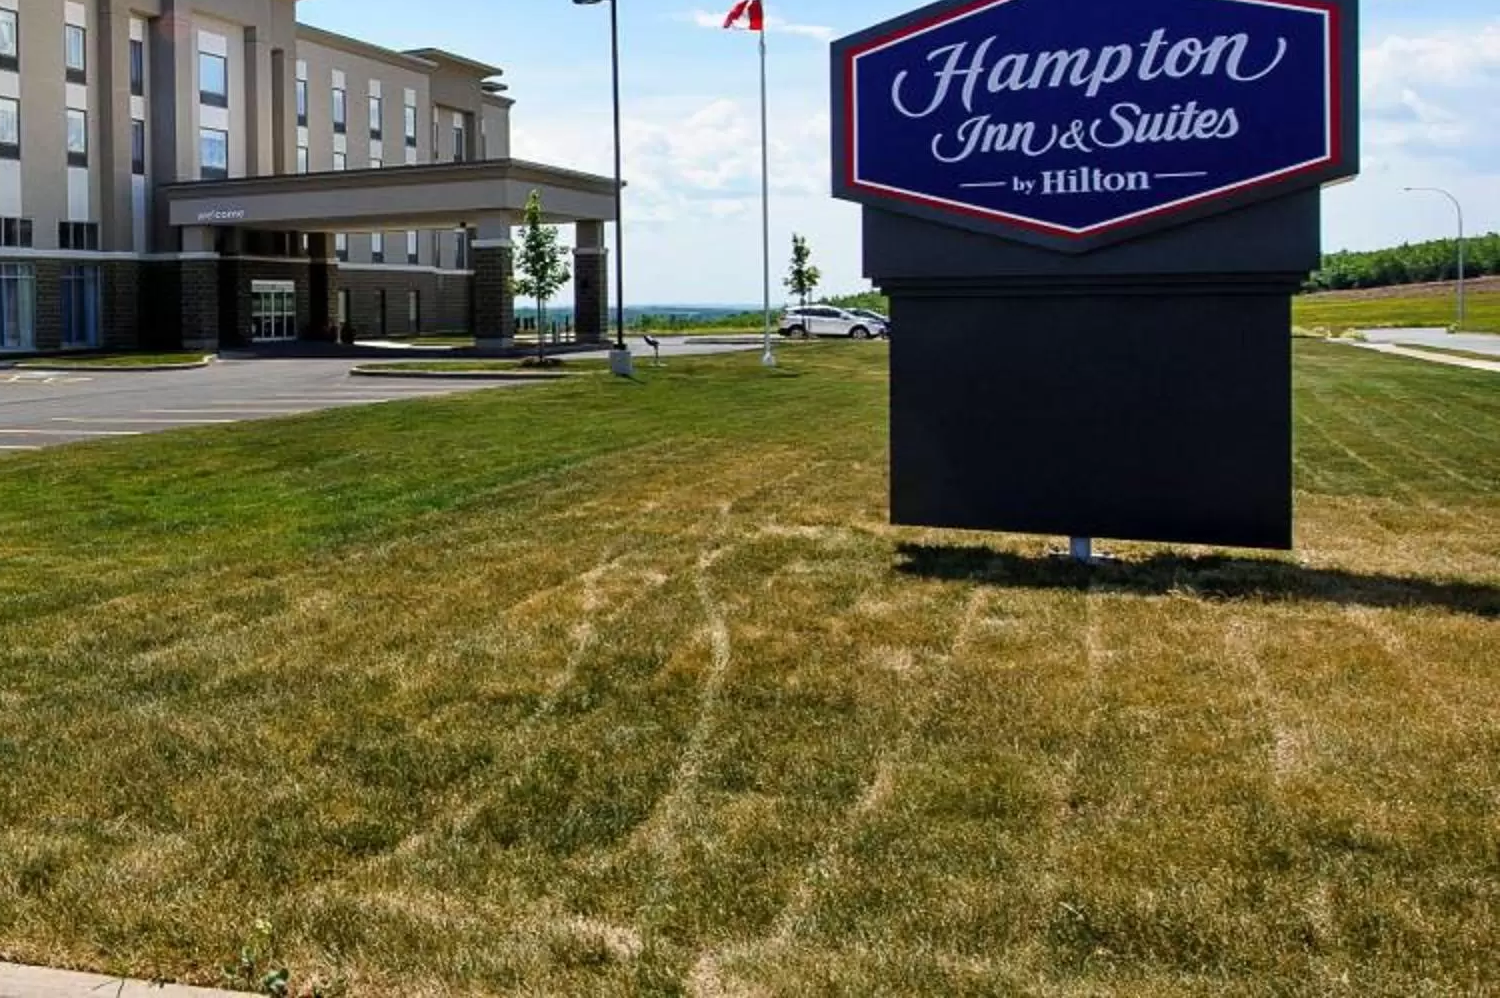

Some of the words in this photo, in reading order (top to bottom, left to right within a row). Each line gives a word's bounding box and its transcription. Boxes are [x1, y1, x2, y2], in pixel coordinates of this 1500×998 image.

[891, 27, 1287, 118] Hampton
[1090, 100, 1240, 149] Suites
[1012, 174, 1037, 196] by
[1040, 166, 1151, 196] Hilton
